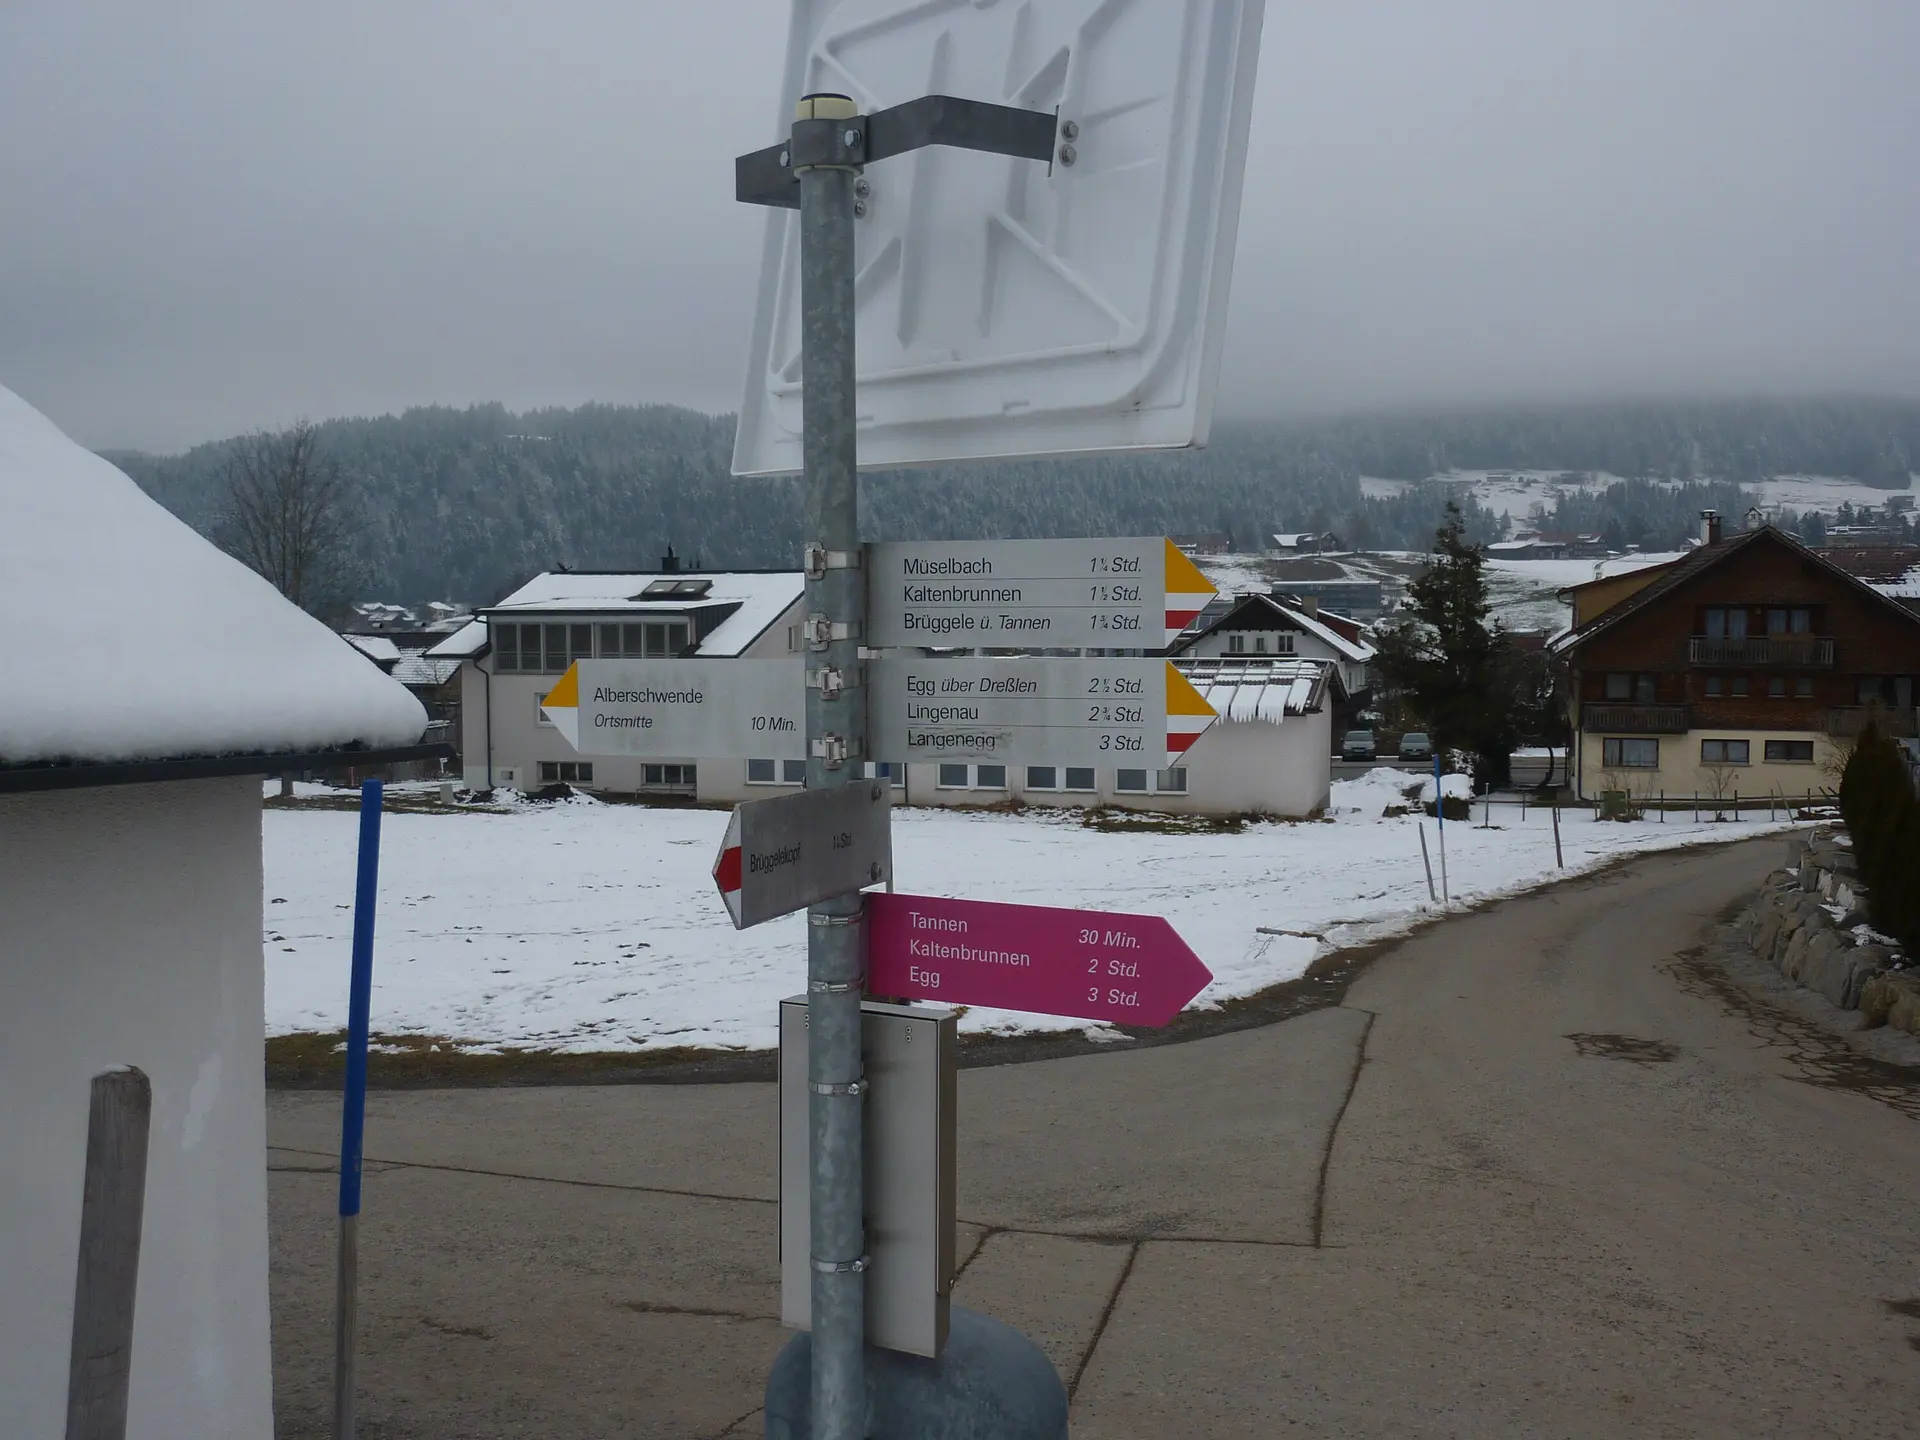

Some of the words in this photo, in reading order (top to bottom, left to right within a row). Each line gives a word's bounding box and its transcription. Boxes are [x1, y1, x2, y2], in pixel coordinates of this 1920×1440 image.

[904, 558, 992, 574] Müselbach
[1112, 557, 1141, 572] Std.
[904, 586, 1021, 602] Kaltenbrunnen
[1112, 586, 1141, 601] Std.
[904, 613, 974, 633] Brüggele
[980, 616, 992, 629] ü.
[999, 615, 1050, 630] Tannen
[1112, 615, 1141, 630] Std.
[594, 688, 703, 703] Alberschwende
[907, 676, 935, 695] Egg
[941, 678, 975, 692] über
[980, 678, 1037, 693] Dreßlen
[1114, 678, 1144, 693] Std.
[595, 714, 653, 728] Ortsmitte
[751, 717, 765, 730] 10
[769, 717, 796, 731] Min.
[907, 703, 979, 723] Lingenau
[1114, 707, 1144, 722] Std.
[907, 729, 996, 751] Langenegg
[1099, 735, 1110, 750] 3
[1114, 736, 1144, 750] Std.
[750, 842, 802, 873] Brüggelekopf
[909, 912, 968, 933] Tannen
[1078, 929, 1098, 944] 30
[1103, 931, 1140, 949] Min.
[910, 939, 1030, 967] Kaltenbrunnen
[1088, 959, 1098, 973] 2
[1108, 960, 1140, 978] Std.
[910, 966, 940, 988] Egg
[1088, 988, 1098, 1001] 3
[1108, 989, 1140, 1007] Std.
